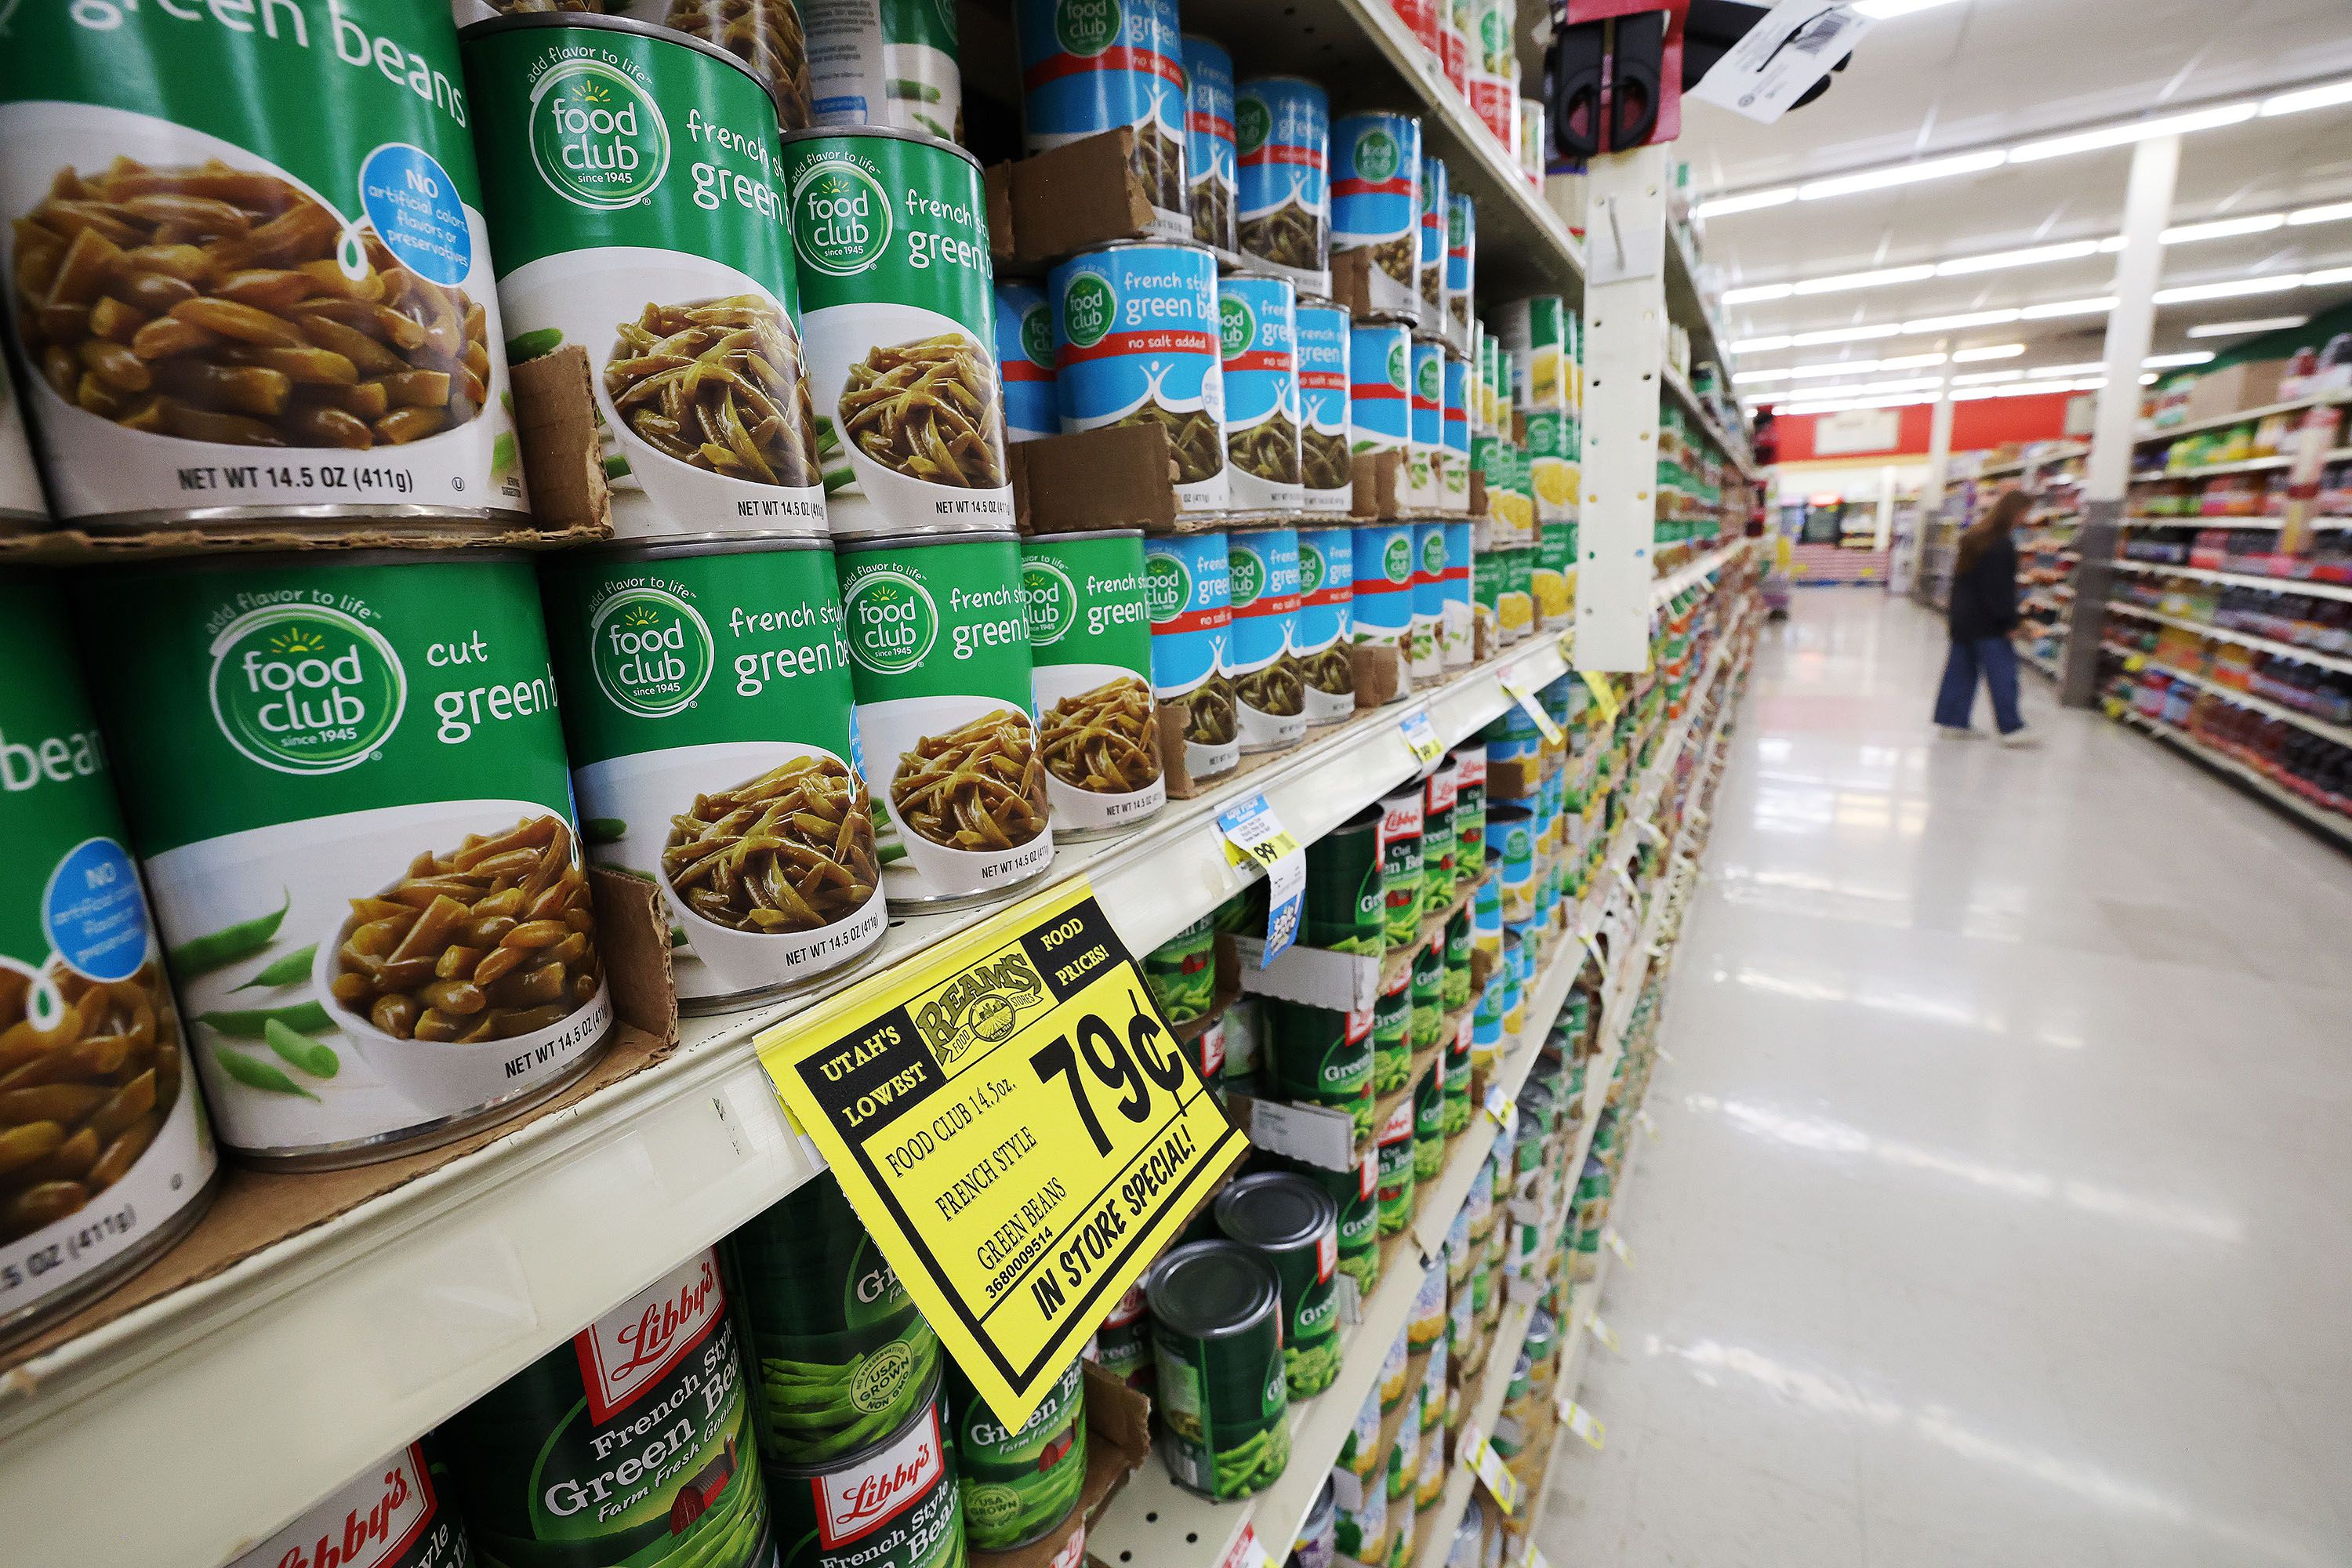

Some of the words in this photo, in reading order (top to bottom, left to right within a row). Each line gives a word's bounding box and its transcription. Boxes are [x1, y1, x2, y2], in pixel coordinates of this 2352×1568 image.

[1069, 17, 1107, 38] club
[329, 0, 466, 128] beans
[527, 56, 549, 84] add
[549, 46, 596, 62] flavor
[601, 48, 619, 64] to
[551, 97, 638, 136] food
[562, 134, 639, 170] club
[686, 107, 770, 170] french
[406, 169, 438, 198] NO
[577, 173, 604, 184] since
[604, 172, 633, 183] 1945
[791, 164, 805, 184] add
[806, 151, 840, 165] flavor
[844, 151, 856, 162] to
[691, 162, 784, 226] green
[808, 190, 869, 220] food
[906, 189, 972, 227] french
[397, 209, 443, 239] flavors
[814, 219, 869, 247] club
[824, 249, 843, 257] since
[844, 245, 864, 255] 1945
[908, 231, 982, 271] green
[1124, 271, 1182, 291] french
[1069, 289, 1102, 312] food
[1072, 307, 1102, 330] club
[1126, 297, 1192, 326] green
[1128, 337, 1145, 350] no
[1147, 334, 1172, 348] salt
[178, 466, 216, 491] NET
[223, 467, 258, 490] WT
[265, 467, 313, 490] 14.5
[320, 467, 347, 488] OZ
[353, 467, 413, 494] (411g)
[738, 501, 760, 517] NET
[762, 501, 779, 516] WT
[781, 501, 800, 516] 14.5
[800, 500, 810, 515] OZ
[935, 501, 953, 514] NET
[956, 500, 969, 514] WT
[971, 500, 987, 514] 14.5
[988, 500, 996, 513] OZ
[843, 573, 858, 591] add
[856, 562, 889, 577] flavor
[891, 561, 903, 572] to
[1040, 554, 1051, 563] to
[589, 591, 606, 614] add
[605, 575, 646, 593] flavor
[650, 575, 666, 589] to
[949, 583, 1012, 613] french
[1087, 572, 1136, 596] french
[1198, 577, 1229, 604] gree
[205, 606, 238, 635] add
[238, 586, 303, 612] flavor
[312, 587, 336, 607] to
[728, 601, 815, 639] french
[858, 595, 916, 625] food
[1028, 602, 1059, 624] lub
[1087, 601, 1145, 636] green
[426, 630, 488, 668] cut
[609, 618, 684, 655] food
[864, 622, 916, 649] club
[874, 648, 893, 657] since
[893, 646, 912, 655] 1945
[952, 619, 1020, 660] green
[242, 644, 364, 693] food
[619, 652, 686, 686] club
[734, 644, 836, 697] green
[633, 686, 656, 697] since
[655, 681, 681, 694] 1945
[257, 684, 365, 733] club
[434, 681, 549, 745] green
[279, 731, 318, 748] since
[318, 726, 358, 744] 1945
[1106, 805, 1120, 816] NET
[1121, 802, 1131, 813] WT
[981, 866, 999, 879] NET
[1001, 861, 1014, 873] WT
[1014, 855, 1029, 868] 14.5
[1029, 853, 1036, 865] OZ
[785, 947, 807, 967] NET
[810, 941, 827, 959] WT
[829, 932, 850, 951] 14.5
[849, 929, 861, 946] OZ
[861, 916, 879, 943] (411g)
[1040, 916, 1085, 952] FOOD
[1054, 943, 1112, 986] PRICES!
[953, 1029, 971, 1054] FOOD
[1011, 993, 1036, 1008] STORES
[504, 1052, 532, 1079] NET
[535, 1040, 555, 1064] WT
[557, 1025, 582, 1051] 14.5
[582, 1016, 593, 1037] OZ
[819, 1025, 902, 1083] UTAH'S
[1029, 988, 1189, 1160] 79¢
[843, 1061, 928, 1127] LOWEST
[884, 1131, 935, 1178] FOOD
[931, 1101, 976, 1152] CLUB
[935, 1160, 998, 1223] FRENCH
[993, 1126, 1040, 1174] STYLE
[975, 1219, 1026, 1271] GREEN
[1021, 1177, 1069, 1227] BEANS
[1029, 1276, 1061, 1322] IN
[1066, 1197, 1129, 1287] STORE
[1123, 1124, 1198, 1215] SPECIAL!
[985, 1225, 1054, 1300] 3680009514
[611, 1261, 715, 1382] Libby's
[859, 1356, 909, 1402] GROWN
[866, 1398, 890, 1410] NON
[892, 1370, 909, 1398] GMO
[870, 1360, 897, 1384] USA
[590, 1372, 701, 1461] French
[971, 1398, 1060, 1446] Gren
[544, 1417, 696, 1517] Green
[597, 1486, 650, 1523] Farm
[655, 1443, 701, 1489] Fresh
[836, 1443, 931, 1525] Libby's
[819, 1528, 908, 1568] French
[911, 1480, 949, 1532] Style
[906, 1484, 960, 1564] Bean
